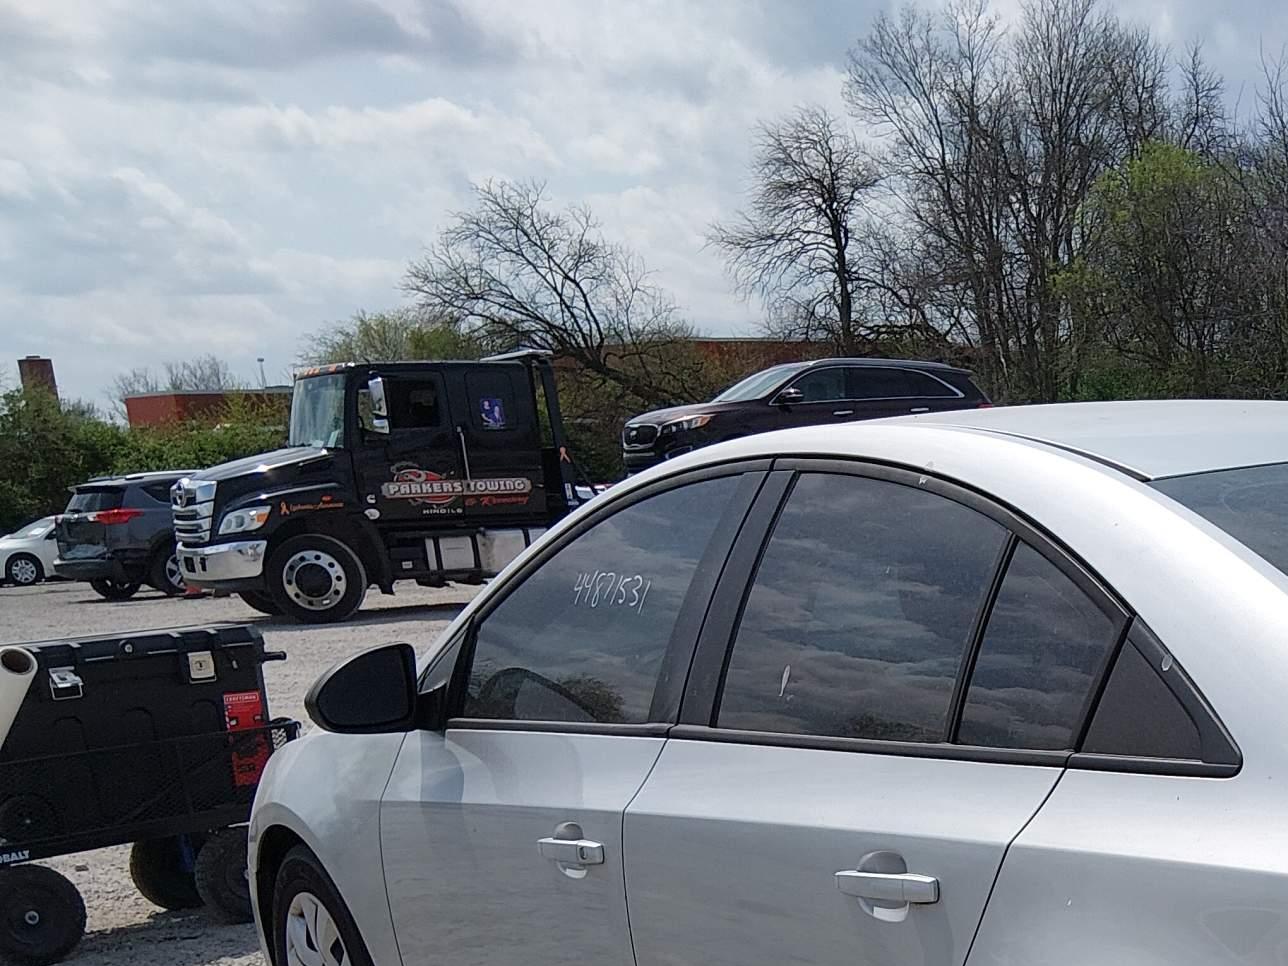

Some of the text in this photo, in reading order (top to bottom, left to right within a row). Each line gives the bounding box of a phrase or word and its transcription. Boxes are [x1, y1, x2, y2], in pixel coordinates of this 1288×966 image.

[389, 480, 525, 495] PARKERS TOWING
[574, 570, 651, 614] 44871531
